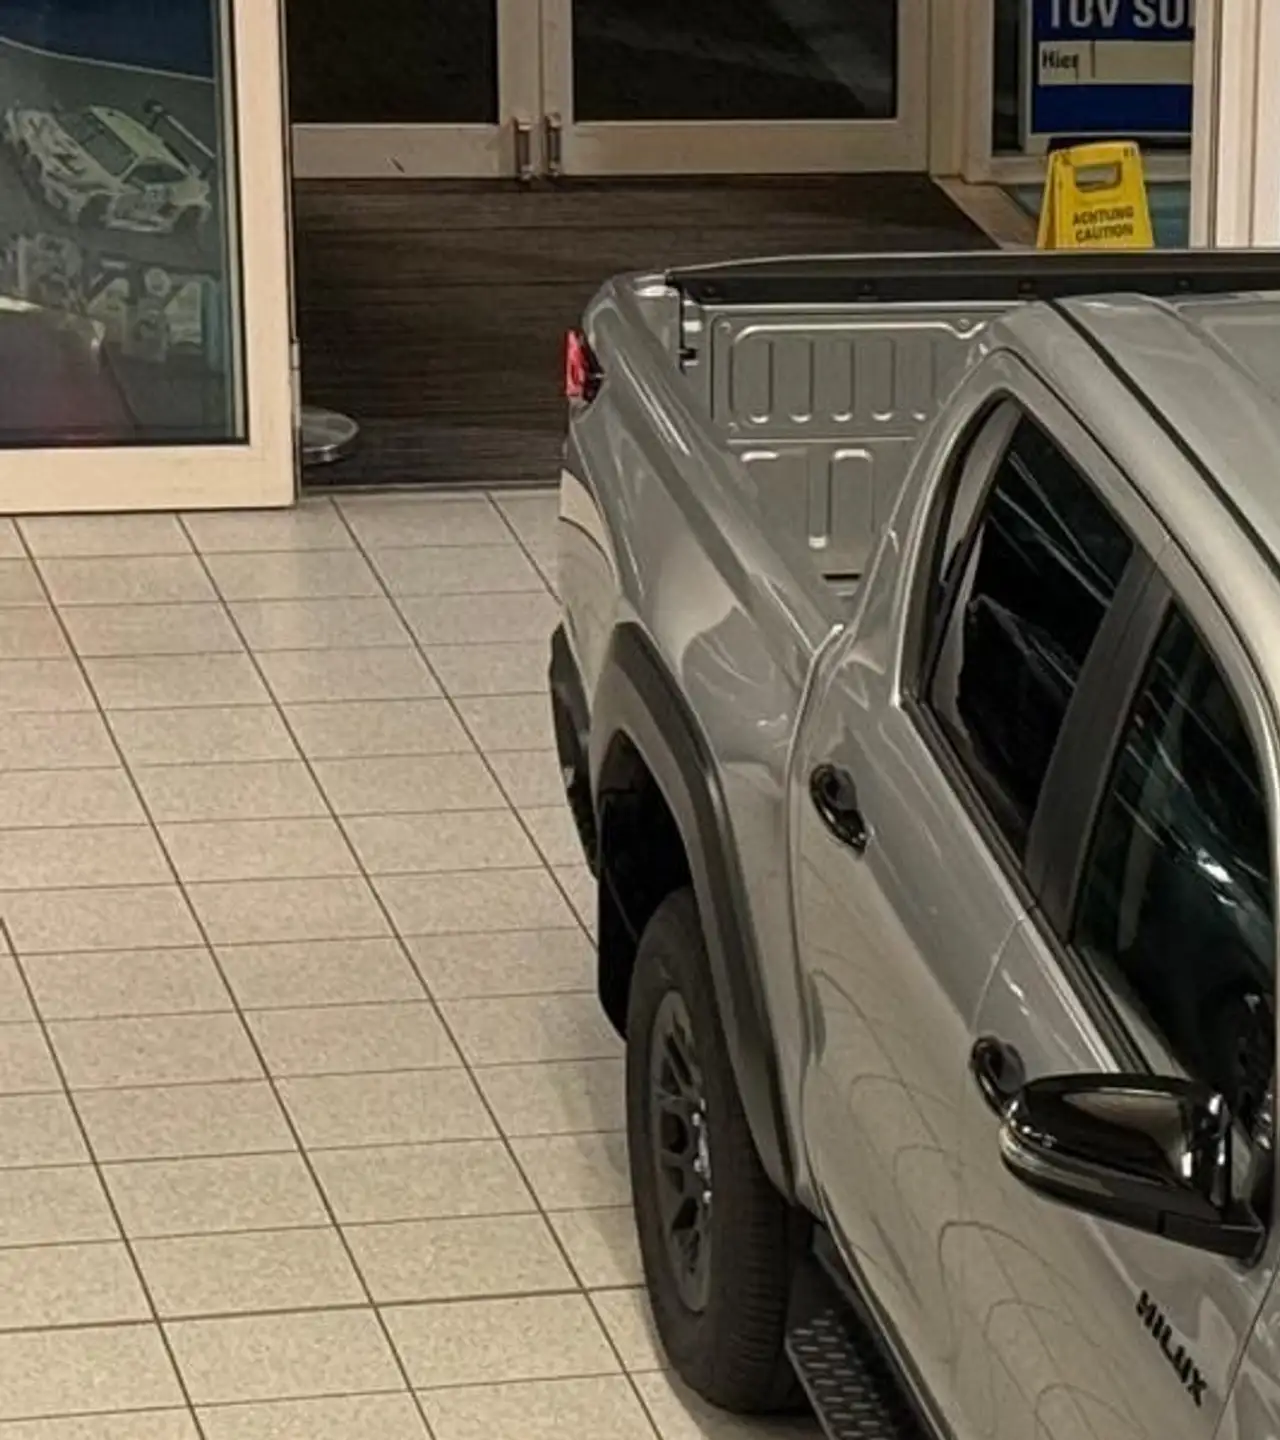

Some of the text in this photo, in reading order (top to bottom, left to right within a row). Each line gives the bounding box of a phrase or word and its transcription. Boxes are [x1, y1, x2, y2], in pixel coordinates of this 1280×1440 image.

[1073, 206, 1133, 226] ACHTUNG
[1075, 223, 1134, 243] CAUTION
[1136, 1290, 1208, 1408] HILUX
